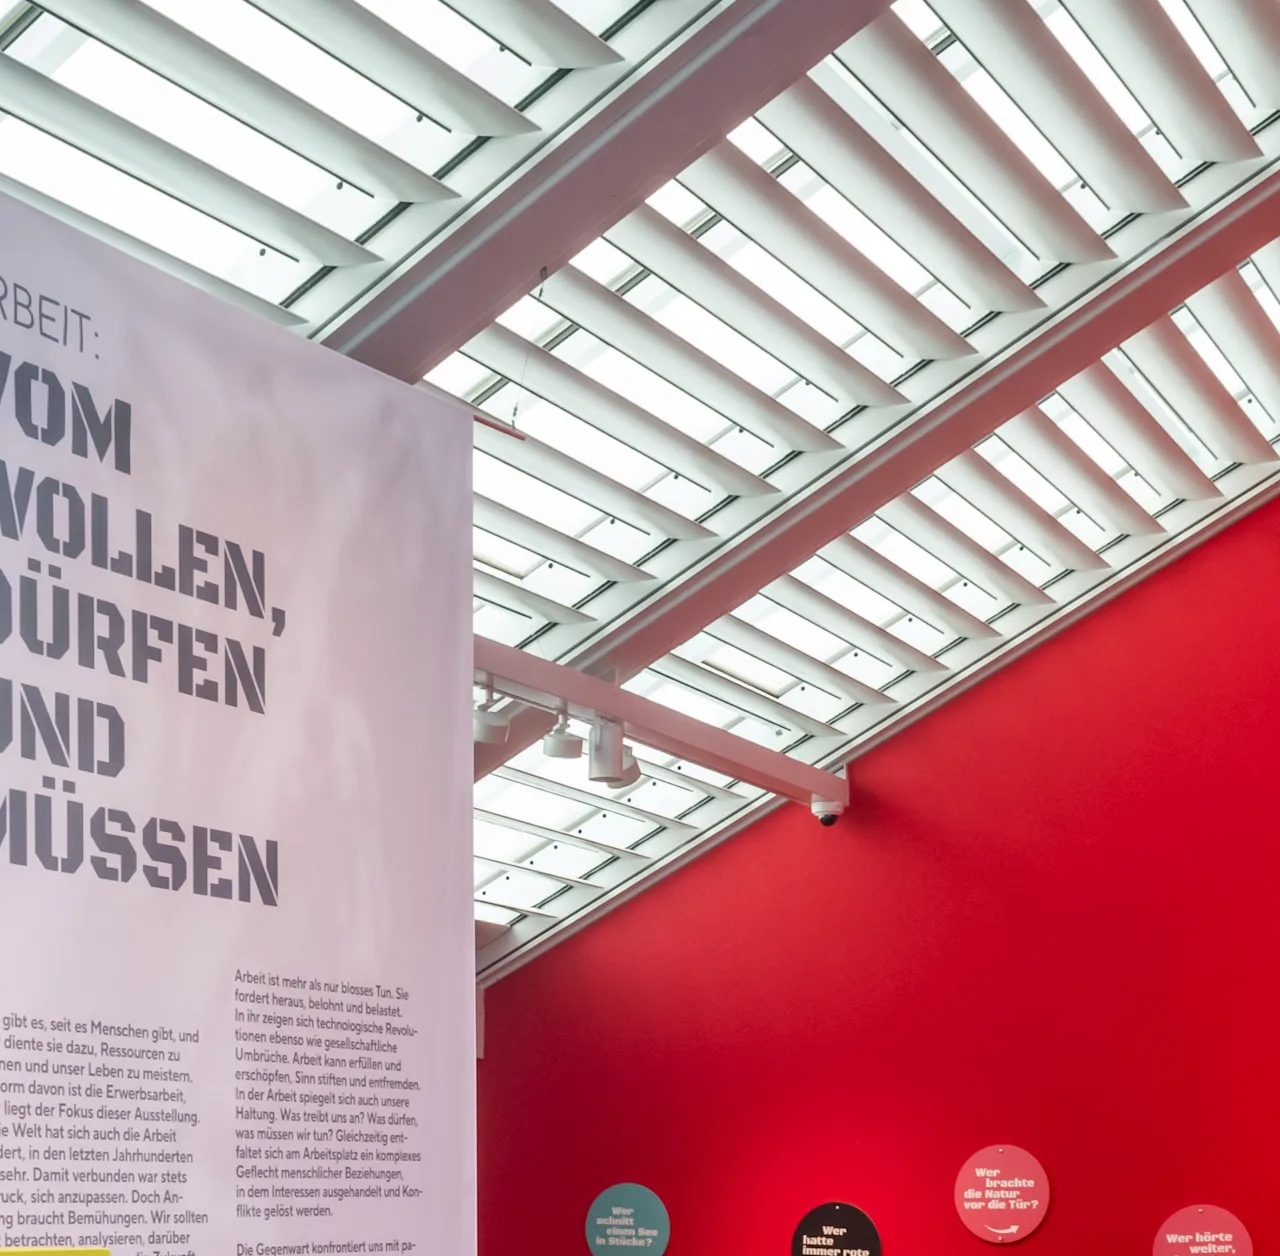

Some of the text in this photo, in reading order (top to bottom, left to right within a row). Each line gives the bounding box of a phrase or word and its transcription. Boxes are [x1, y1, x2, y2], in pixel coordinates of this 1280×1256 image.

[235, 969, 408, 1000] Arbeit ist mehr als nur blosses Tun. Sie
[235, 989, 402, 1017] fordert heraus, belohnt und belastet.
[3, 1013, 27, 1030] gibt
[31, 1019, 47, 1031] es,
[51, 1018, 71, 1032] seit
[75, 1023, 87, 1033] es
[91, 1020, 148, 1038] Menschen
[152, 1027, 175, 1043] gibt,
[179, 1030, 198, 1042] und
[4, 1034, 43, 1051] diente
[47, 1038, 63, 1052] sie
[66, 1040, 97, 1056] dazu,
[101, 1042, 164, 1060] Ressourcen
[168, 1052, 180, 1061] zu
[26, 1059, 48, 1073] und
[52, 1064, 84, 1075] unser
[89, 1062, 124, 1078] Leben
[127, 1069, 140, 1079] zu
[143, 1068, 192, 1082] meistern.
[28, 1080, 64, 1095] davon
[68, 1082, 82, 1096] ist
[85, 1084, 102, 1098] die
[106, 1084, 186, 1104] Erwerbsarbeit,
[4, 1100, 31, 1119] liegt
[35, 1102, 55, 1116] der
[59, 1103, 93, 1118] Fokus
[97, 1105, 131, 1120] dieser
[134, 1107, 200, 1126] Ausstellung.
[12, 1123, 42, 1138] Welt
[46, 1124, 64, 1138] hat
[68, 1125, 90, 1139] sich
[93, 1127, 120, 1140] auch
[123, 1128, 140, 1141] die
[143, 1128, 176, 1142] Arbeit
[29, 1145, 39, 1160] in
[43, 1146, 66, 1160] den
[70, 1146, 109, 1161] letzten
[112, 1148, 193, 1163] Jahrhunderten
[0, 1167, 29, 1181] sehr.
[34, 1167, 69, 1182] Damit
[72, 1168, 134, 1182] verbunden
[138, 1174, 158, 1182] war
[161, 1171, 187, 1183] stets
[975, 1167, 1000, 1177] Wer
[986, 1178, 1034, 1188] brachte
[964, 1189, 1020, 1198] die Natur
[988, 1199, 1006, 1209] die
[1009, 1199, 1038, 1209] Tür?
[612, 1207, 634, 1215] Wer
[18, 1211, 64, 1225] braucht
[68, 1210, 147, 1228] Bemühungen.
[150, 1210, 170, 1224] Wir
[174, 1210, 208, 1224] sollten
[596, 1216, 634, 1226] schnitt
[606, 1227, 658, 1236] einen See
[822, 1226, 847, 1236] Wer
[596, 1235, 653, 1246] in Stücke?
[803, 1235, 834, 1246] hatte
[1166, 1232, 1233, 1243] Wer hörte
[237, 1244, 253, 1256] Die
[312, 1241, 366, 1254] konfrontiert
[369, 1243, 383, 1252] uns
[386, 1240, 399, 1251] mit
[402, 1242, 416, 1253] pa-
[802, 1245, 841, 1256] immer
[1189, 1244, 1236, 1254] weiter,
